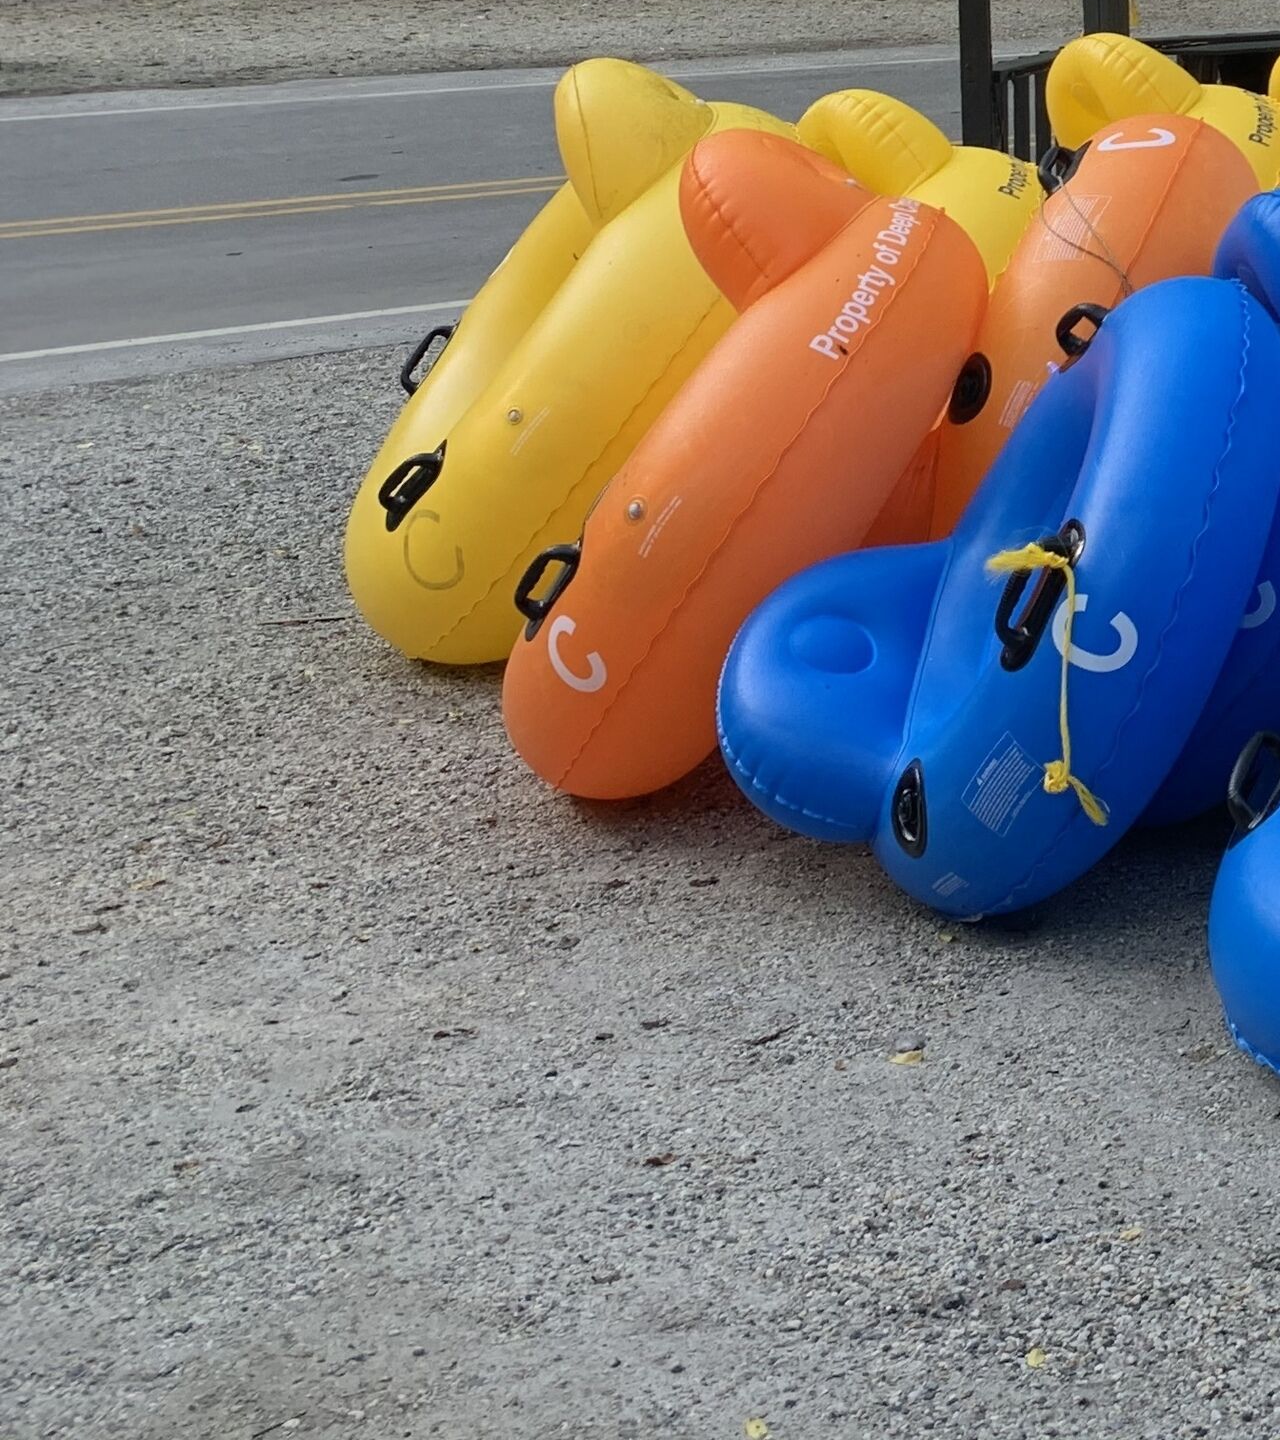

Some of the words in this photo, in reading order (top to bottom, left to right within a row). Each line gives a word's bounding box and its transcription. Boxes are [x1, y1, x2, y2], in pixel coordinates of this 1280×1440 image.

[1097, 127, 1176, 152] C
[873, 242, 902, 265] of
[877, 211, 922, 247] Deep
[809, 264, 896, 360] Property
[404, 509, 465, 591] C
[547, 615, 607, 692] C
[1051, 593, 1138, 673] C
